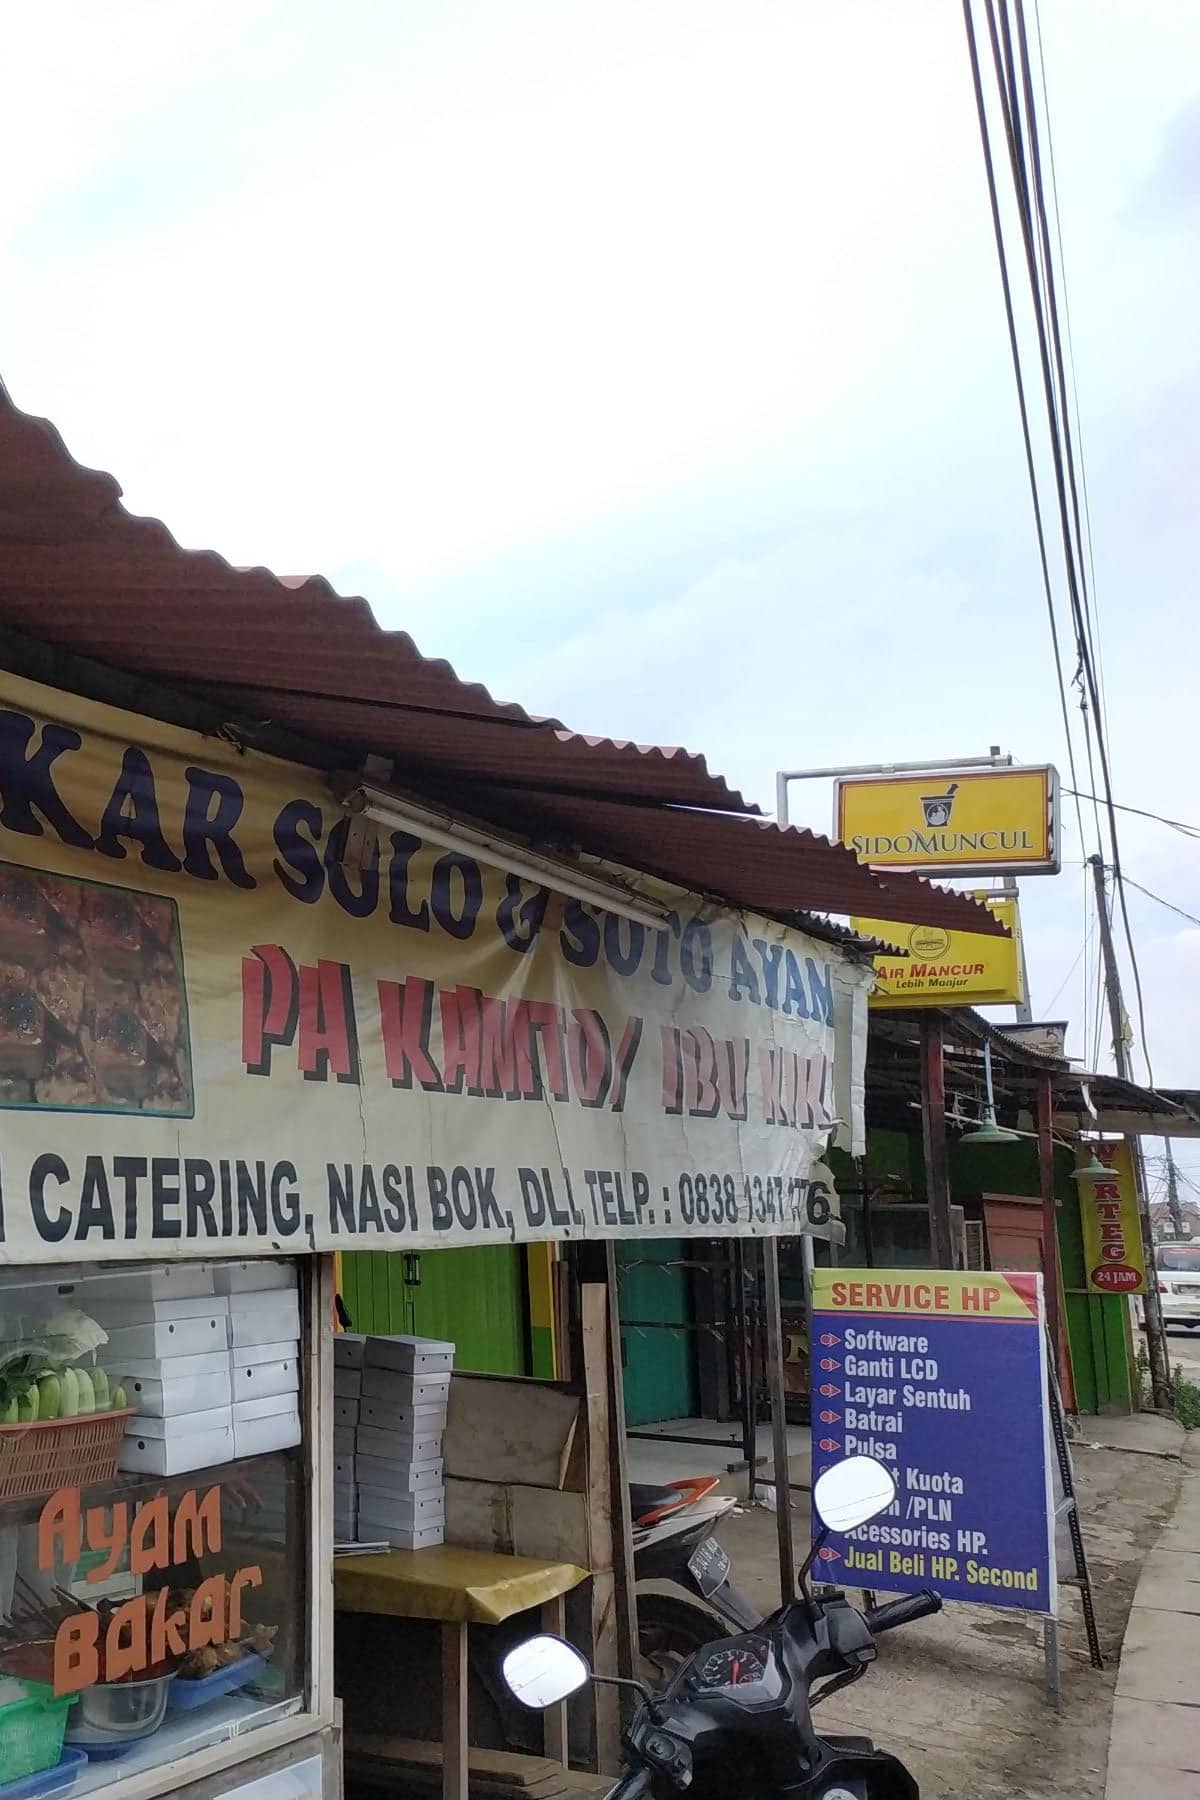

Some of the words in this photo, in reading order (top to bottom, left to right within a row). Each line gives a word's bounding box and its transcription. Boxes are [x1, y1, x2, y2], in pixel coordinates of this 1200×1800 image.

[851, 829, 1033, 856] SIDOMUNCUL
[273, 799, 483, 939] SOLO
[496, 872, 548, 953] &
[560, 897, 714, 993] SOTO
[875, 965, 904, 980] AIR
[909, 963, 985, 978] MANCUR
[896, 979, 924, 989] Lebih
[928, 978, 969, 988] Manjur
[242, 944, 362, 1085] PA
[661, 1025, 750, 1121] IBU
[759, 1046, 834, 1131] KIK
[28, 1152, 316, 1250] CATERING,
[326, 1163, 418, 1235] NASI
[426, 1165, 515, 1240] BOK,
[584, 1169, 655, 1226] TELP.
[678, 1172, 738, 1225] 0838
[1088, 1143, 1126, 1260] WRTEG
[1097, 1271, 1111, 1282] 24
[1113, 1271, 1137, 1284] JAM
[831, 1282, 949, 1311] SERVICE
[961, 1287, 1001, 1312] HP
[844, 1328, 929, 1354] Software
[844, 1355, 894, 1379] Ganti
[900, 1358, 938, 1381] LCD
[844, 1382, 896, 1407] Layar
[902, 1386, 971, 1411] Sentuh
[844, 1409, 903, 1433] Batrai
[844, 1435, 897, 1460] Pulsa
[906, 1467, 964, 1495] Kuota
[905, 1496, 953, 1522] /PLN
[956, 1530, 989, 1555] HP.
[844, 1546, 883, 1573] Jual
[889, 1551, 925, 1576] Beli
[931, 1555, 960, 1581] HP.
[966, 1562, 1038, 1591] Second
